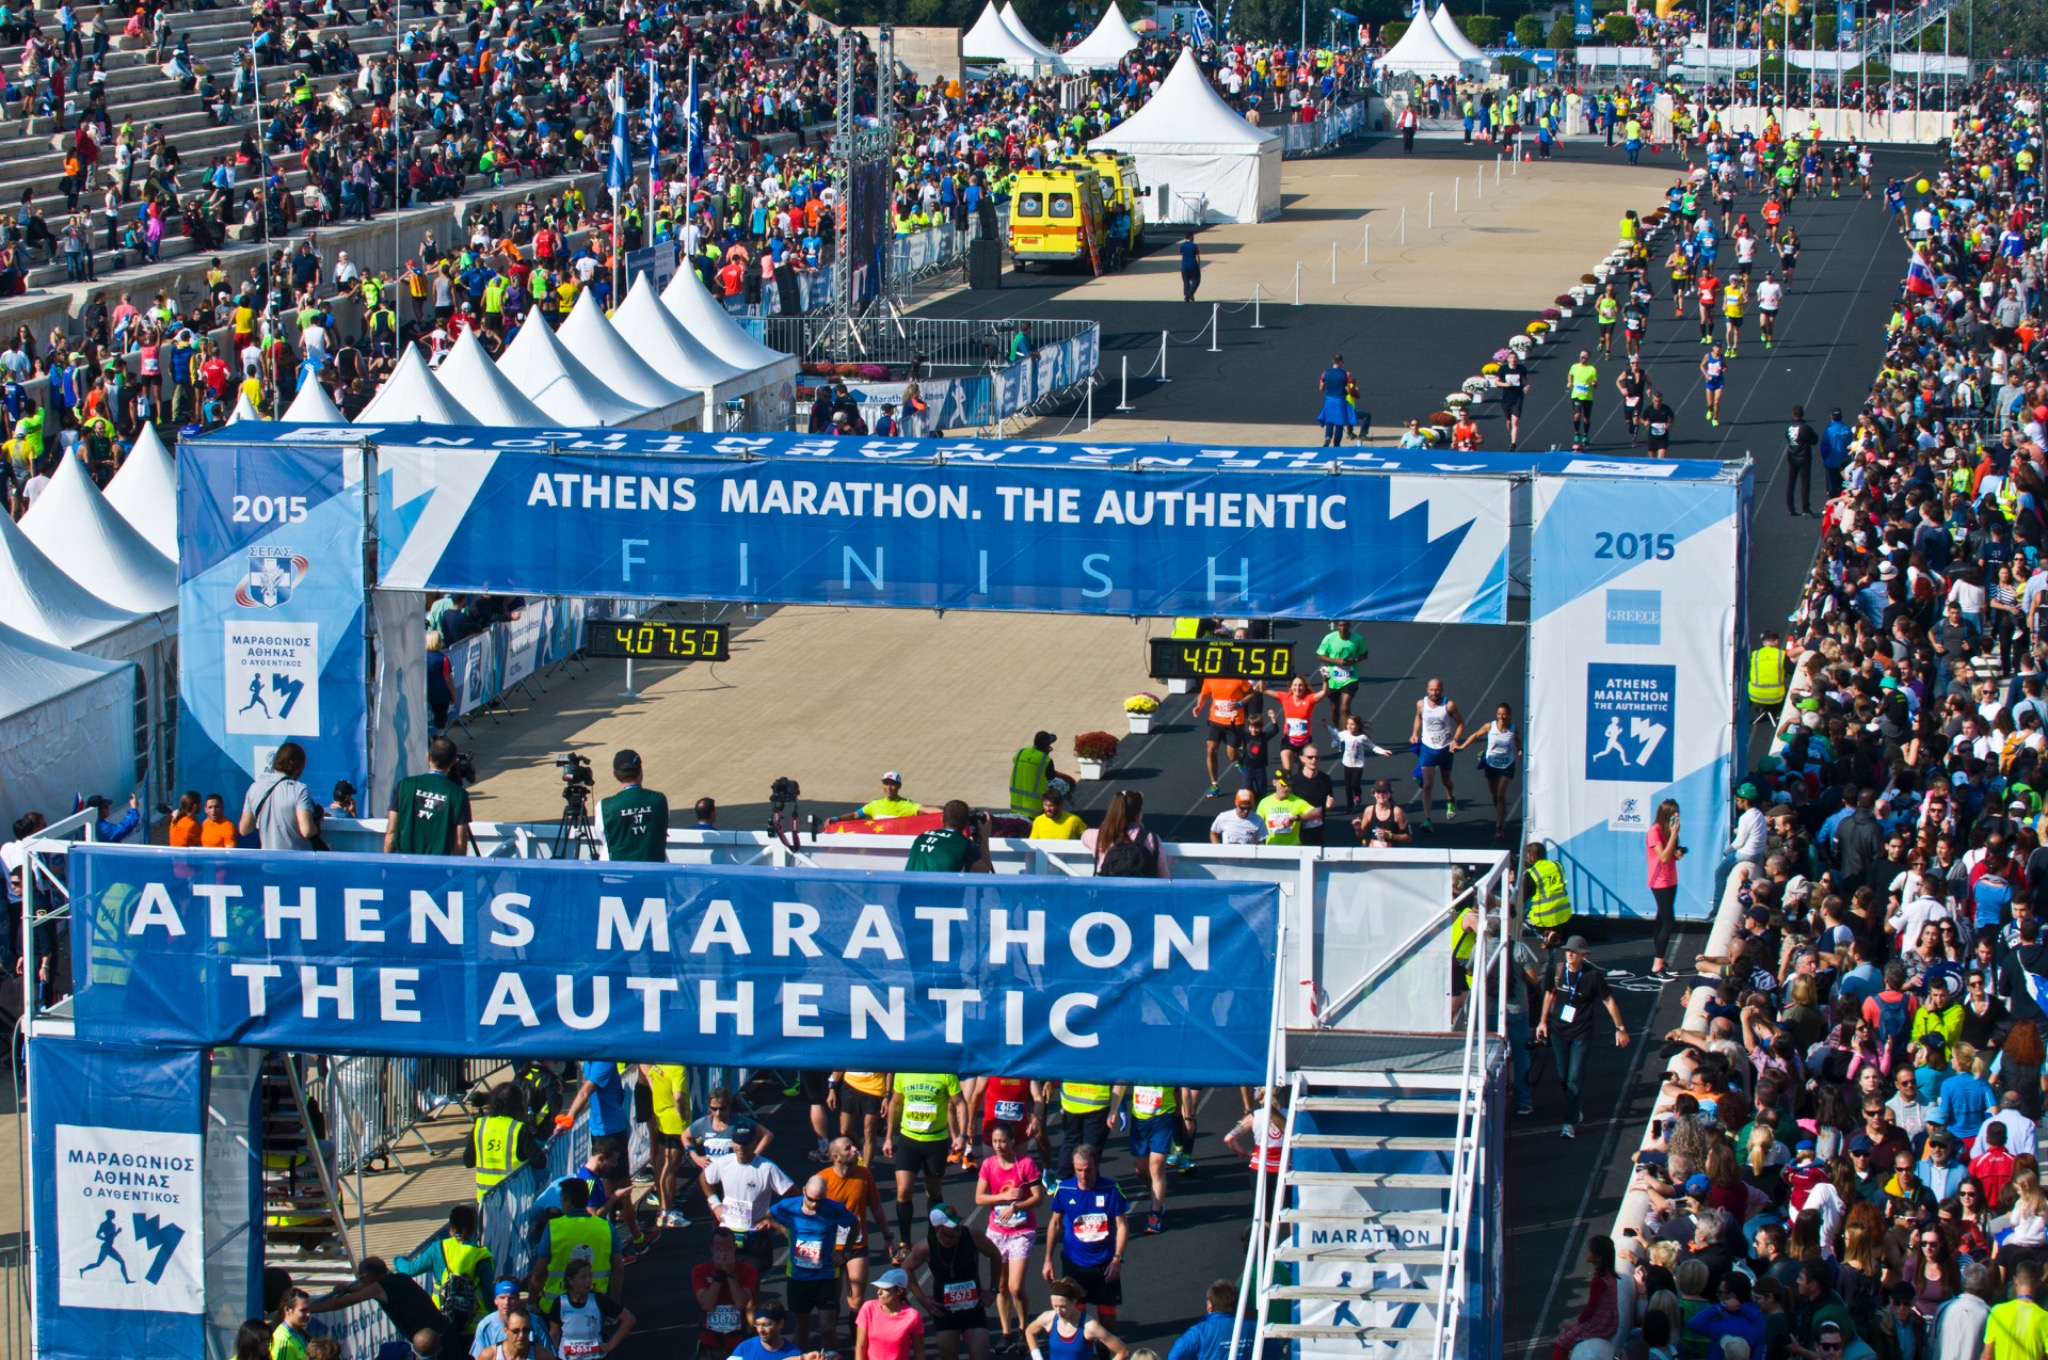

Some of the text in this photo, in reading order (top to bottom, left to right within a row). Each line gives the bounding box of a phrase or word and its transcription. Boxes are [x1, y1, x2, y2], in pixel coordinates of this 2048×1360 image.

[1196, 449, 1386, 461] THE
[528, 473, 1347, 529] ATHENS MARATHON. THE AUTHENTIC
[232, 495, 308, 523] 2015
[250, 546, 292, 557] ΣΕΓΑΣ
[1594, 531, 1675, 561] 2015
[622, 539, 1249, 601] FINISH
[1607, 610, 1660, 621] GREECE
[232, 635, 311, 647] ΜΑΡΑΘΩΝΙΟΣ
[247, 647, 296, 658] ΑΘΗΝΑΣ
[250, 659, 302, 668] ΑΥΘΕΝΤΙΚΟΣ
[1606, 678, 1657, 690] ATHENS
[1594, 690, 1669, 702] MARATHON
[1594, 702, 1668, 712] THE AUTHENTIC
[424, 799, 434, 809] 32
[417, 810, 433, 820] TV
[633, 815, 643, 824] 37
[1618, 814, 1641, 823] AIMS
[632, 825, 647, 835] TV
[920, 845, 934, 853] TV
[128, 883, 1210, 971] ATHENS MARATHON
[231, 964, 1099, 1048] THE AUTHENTIC
[911, 1112, 930, 1120] 1299
[487, 1139, 502, 1151] 53
[68, 1150, 194, 1171] ΜΑΡΑΘΩΝΙΟΣ
[94, 1170, 170, 1188] ΑΘΗΝΑΣ
[83, 1187, 180, 1203] Ο ΑΥΘΕΝΤΙΚΟΣ
[1312, 1229, 1430, 1244] MARATHON
[950, 1291, 972, 1301] 5673
[570, 1345, 592, 1354] 5651
